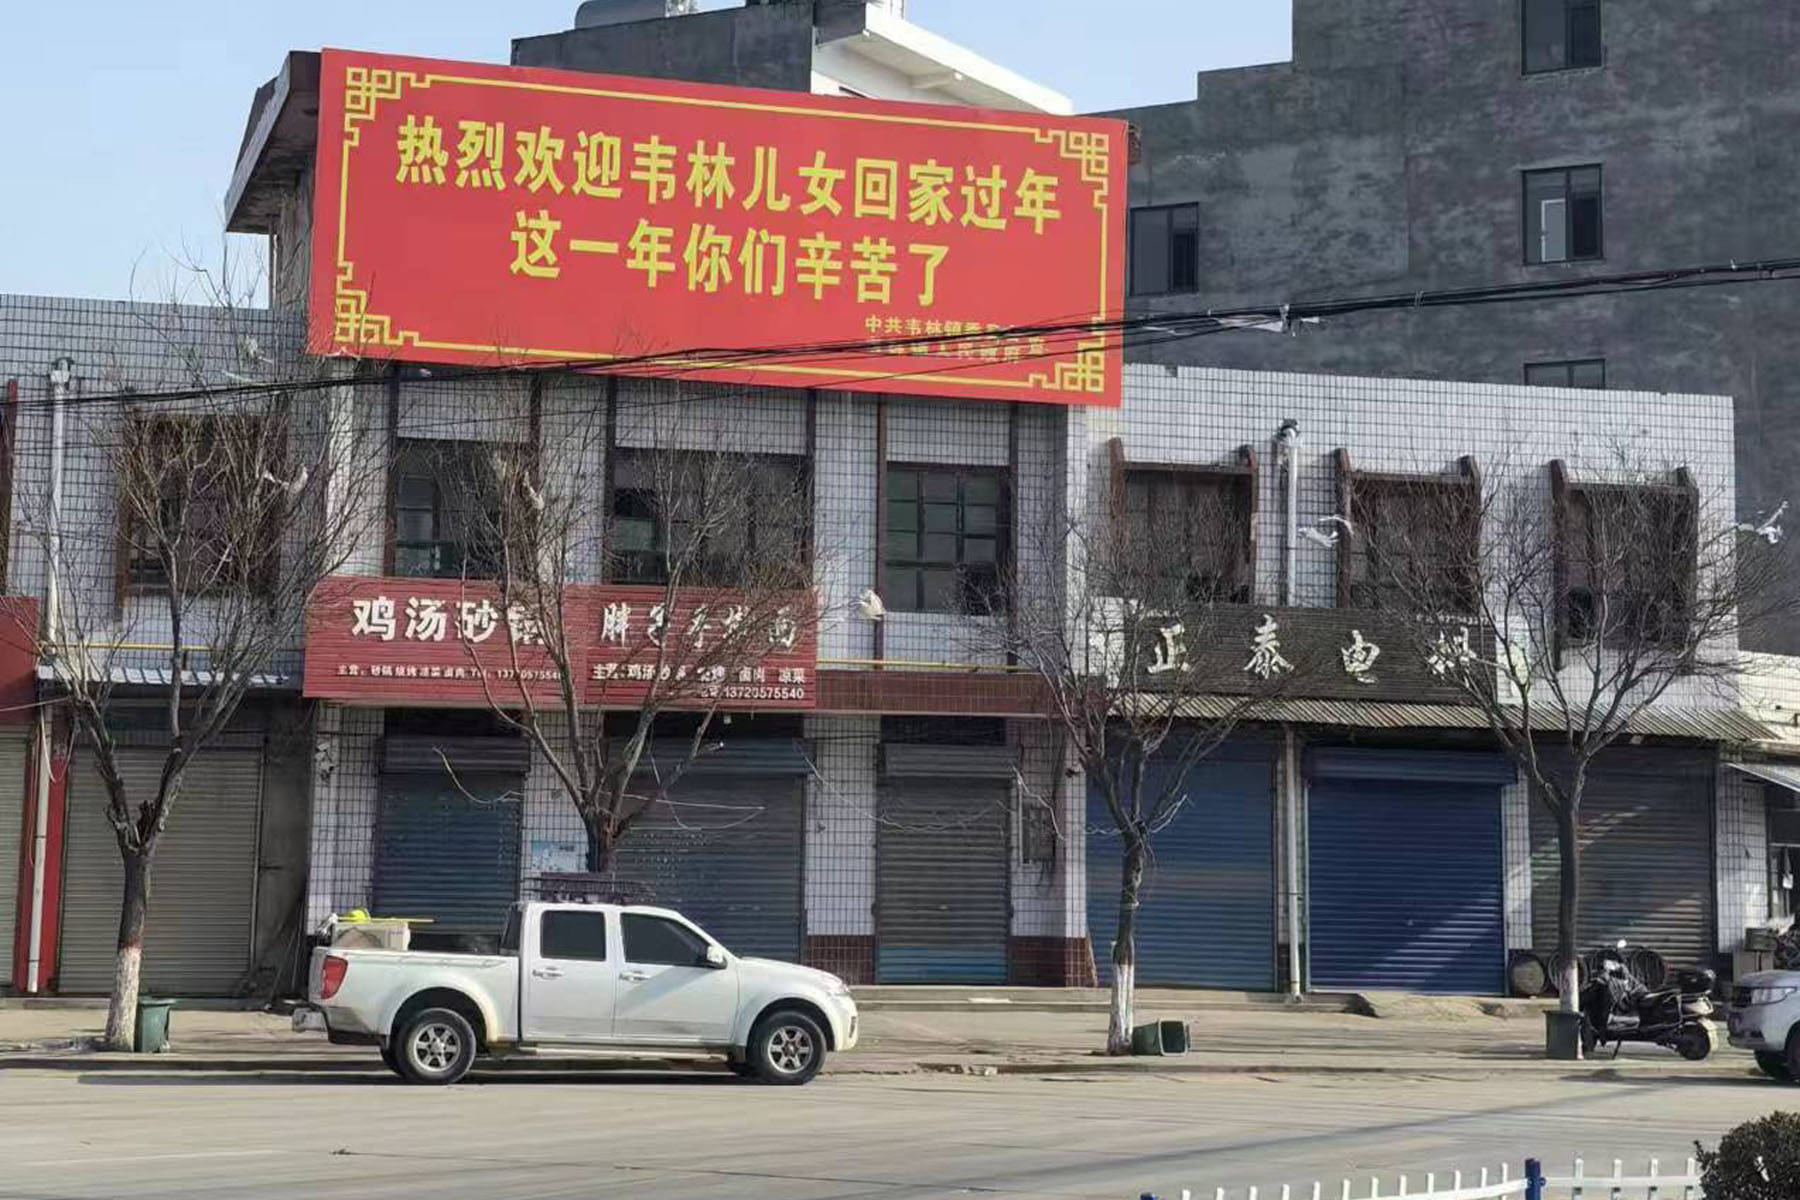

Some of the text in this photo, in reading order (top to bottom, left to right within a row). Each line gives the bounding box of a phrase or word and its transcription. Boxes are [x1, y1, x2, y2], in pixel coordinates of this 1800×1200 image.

[395, 114, 1061, 236] 热烈欢迎韦林儿女回家过年
[510, 210, 949, 307] 这一年你们辛苦了
[864, 314, 1020, 343] 中共韦林镇委
